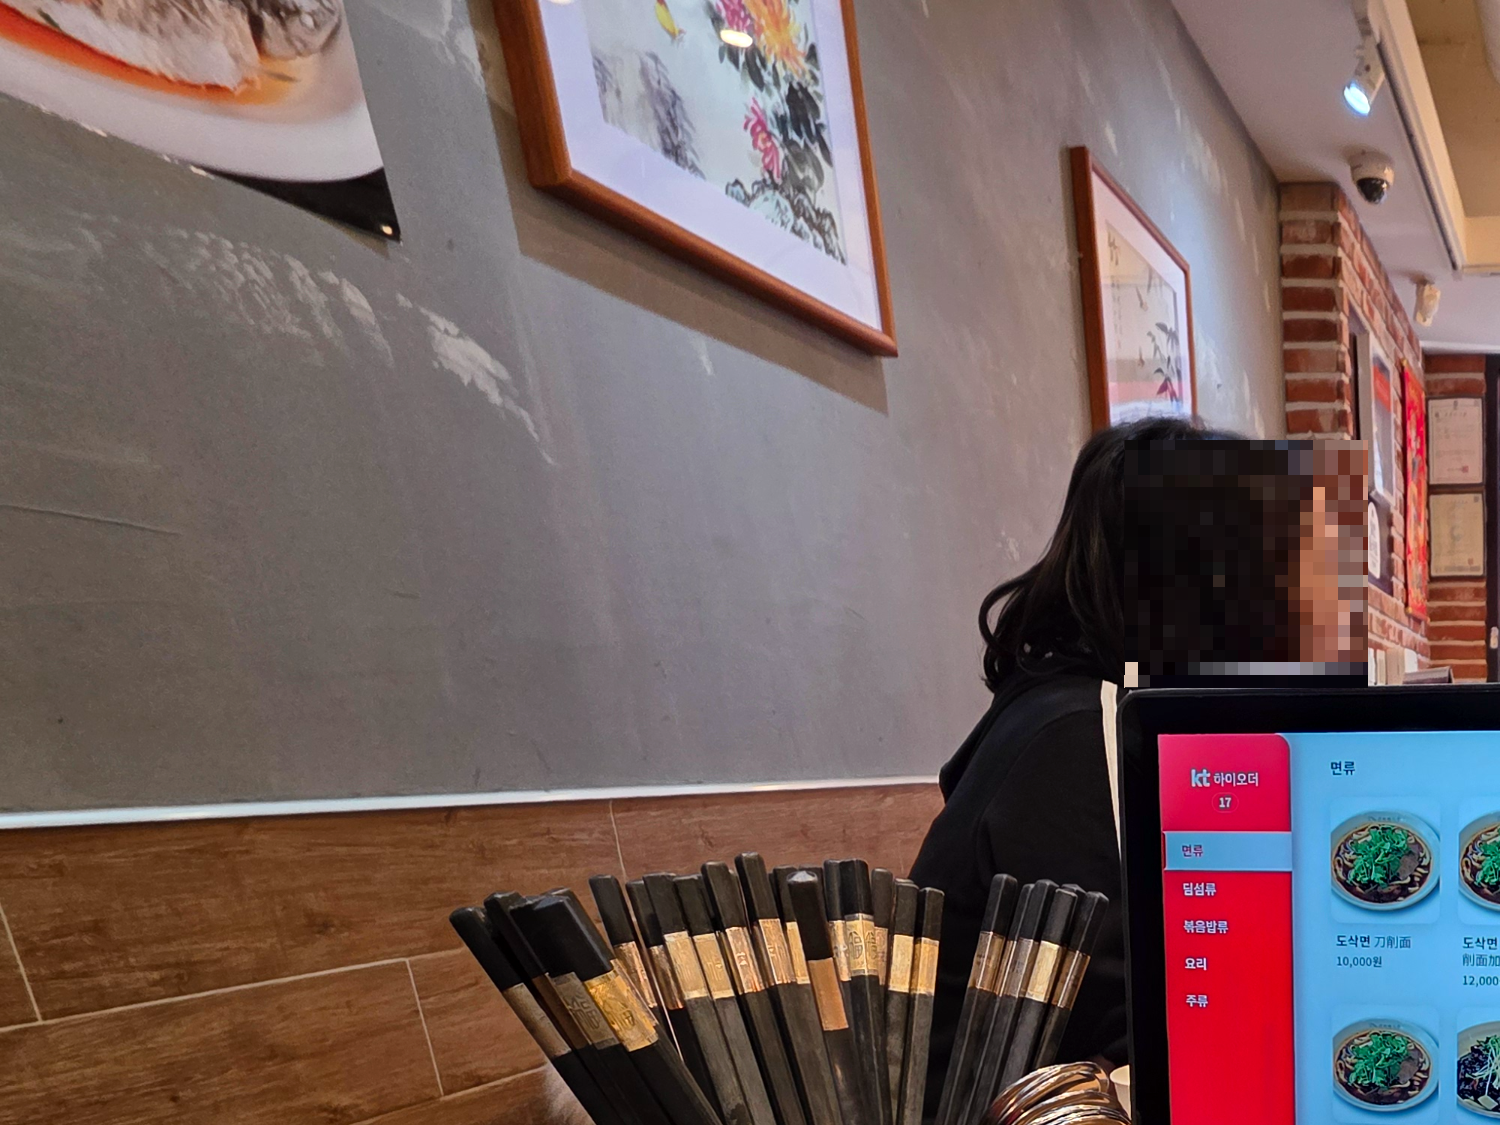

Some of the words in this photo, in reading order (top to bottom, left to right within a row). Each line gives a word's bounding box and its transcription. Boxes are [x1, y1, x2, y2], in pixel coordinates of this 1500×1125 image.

[1330, 761, 1356, 776] 면류
[1190, 769, 1210, 788] kt
[1213, 772, 1259, 788] 하이오더
[1218, 797, 1232, 809] 17
[1181, 845, 1203, 858] 면류
[1182, 882, 1217, 896] 딤섬류
[1183, 920, 1229, 934] 볶음밥류
[1336, 935, 1371, 949] 도삭면
[1374, 936, 1412, 950] 刀削面
[1463, 937, 1498, 951] 도삭면
[1185, 957, 1207, 971] 요리
[1336, 956, 1383, 969] 10,000원
[1186, 994, 1208, 1008] 주류
